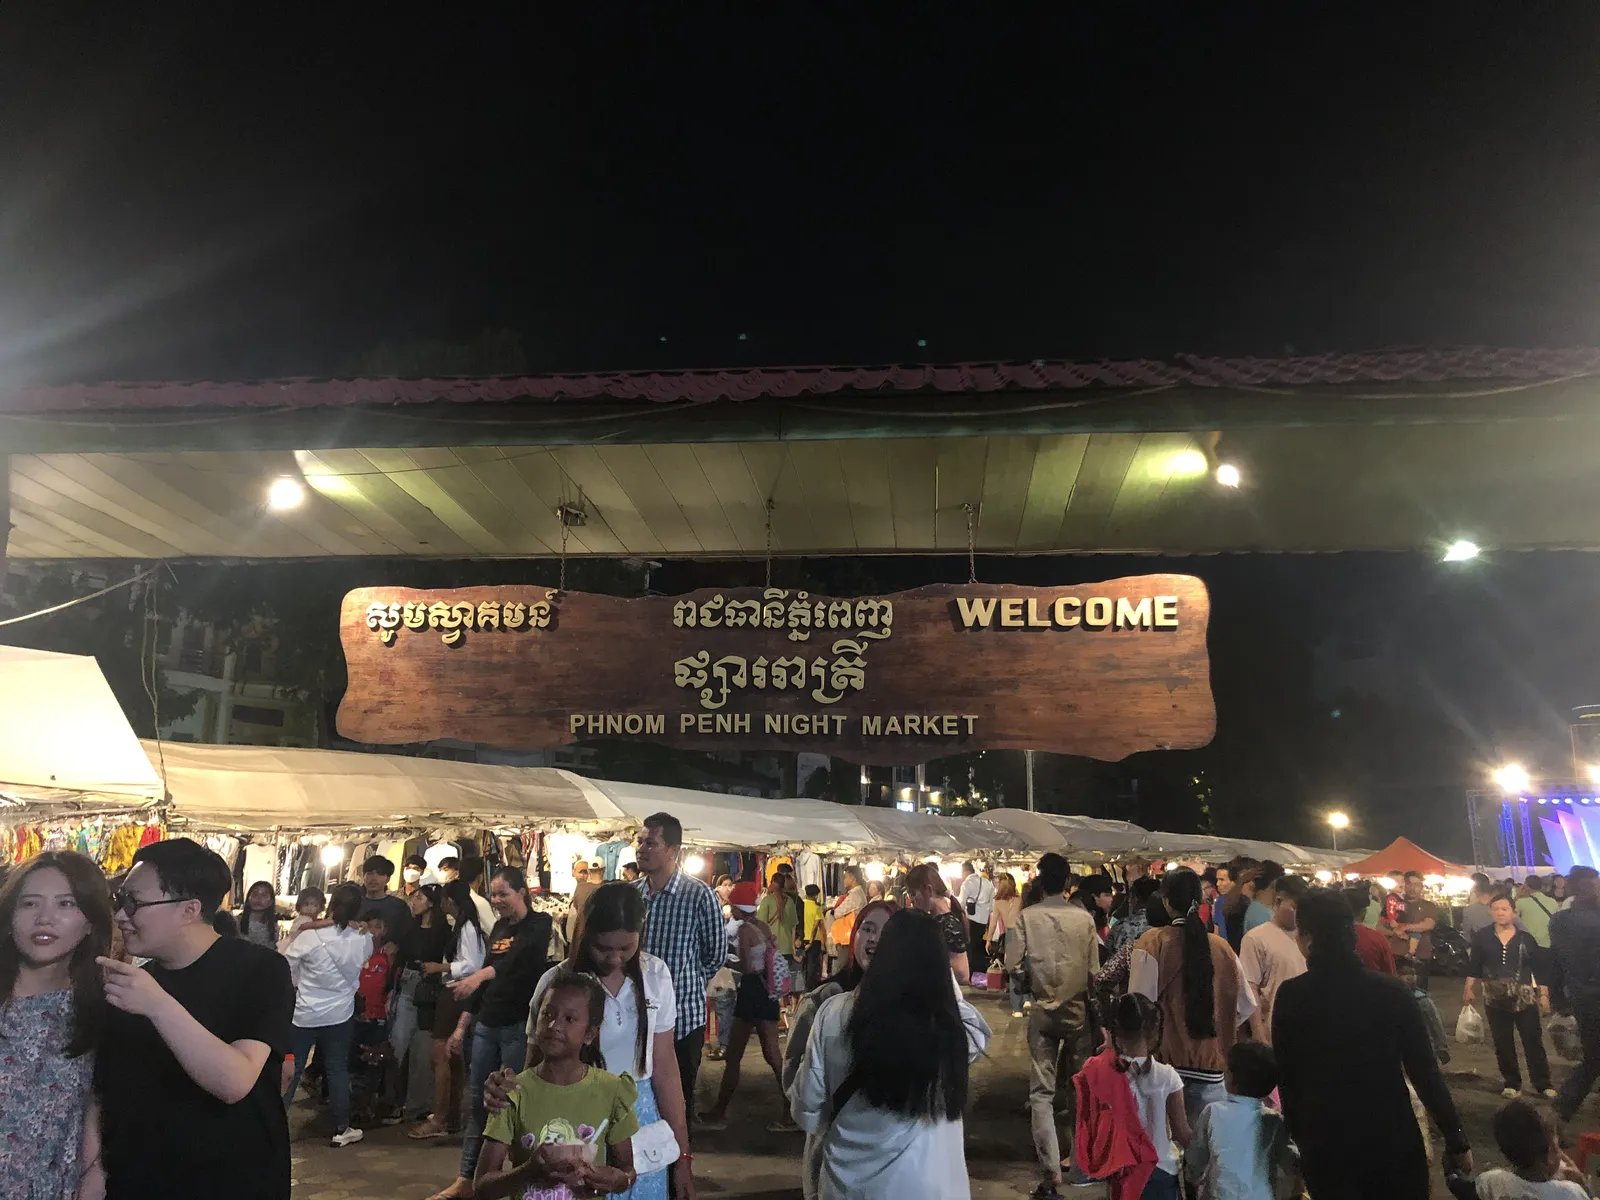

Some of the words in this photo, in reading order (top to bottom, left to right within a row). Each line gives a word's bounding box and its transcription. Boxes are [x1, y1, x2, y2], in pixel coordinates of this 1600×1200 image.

[956, 596, 1179, 628] WELCOME
[570, 714, 665, 734] PHNOM
[680, 713, 751, 733] PENH
[764, 714, 848, 735] NIGHT
[862, 714, 979, 735] MARKET
